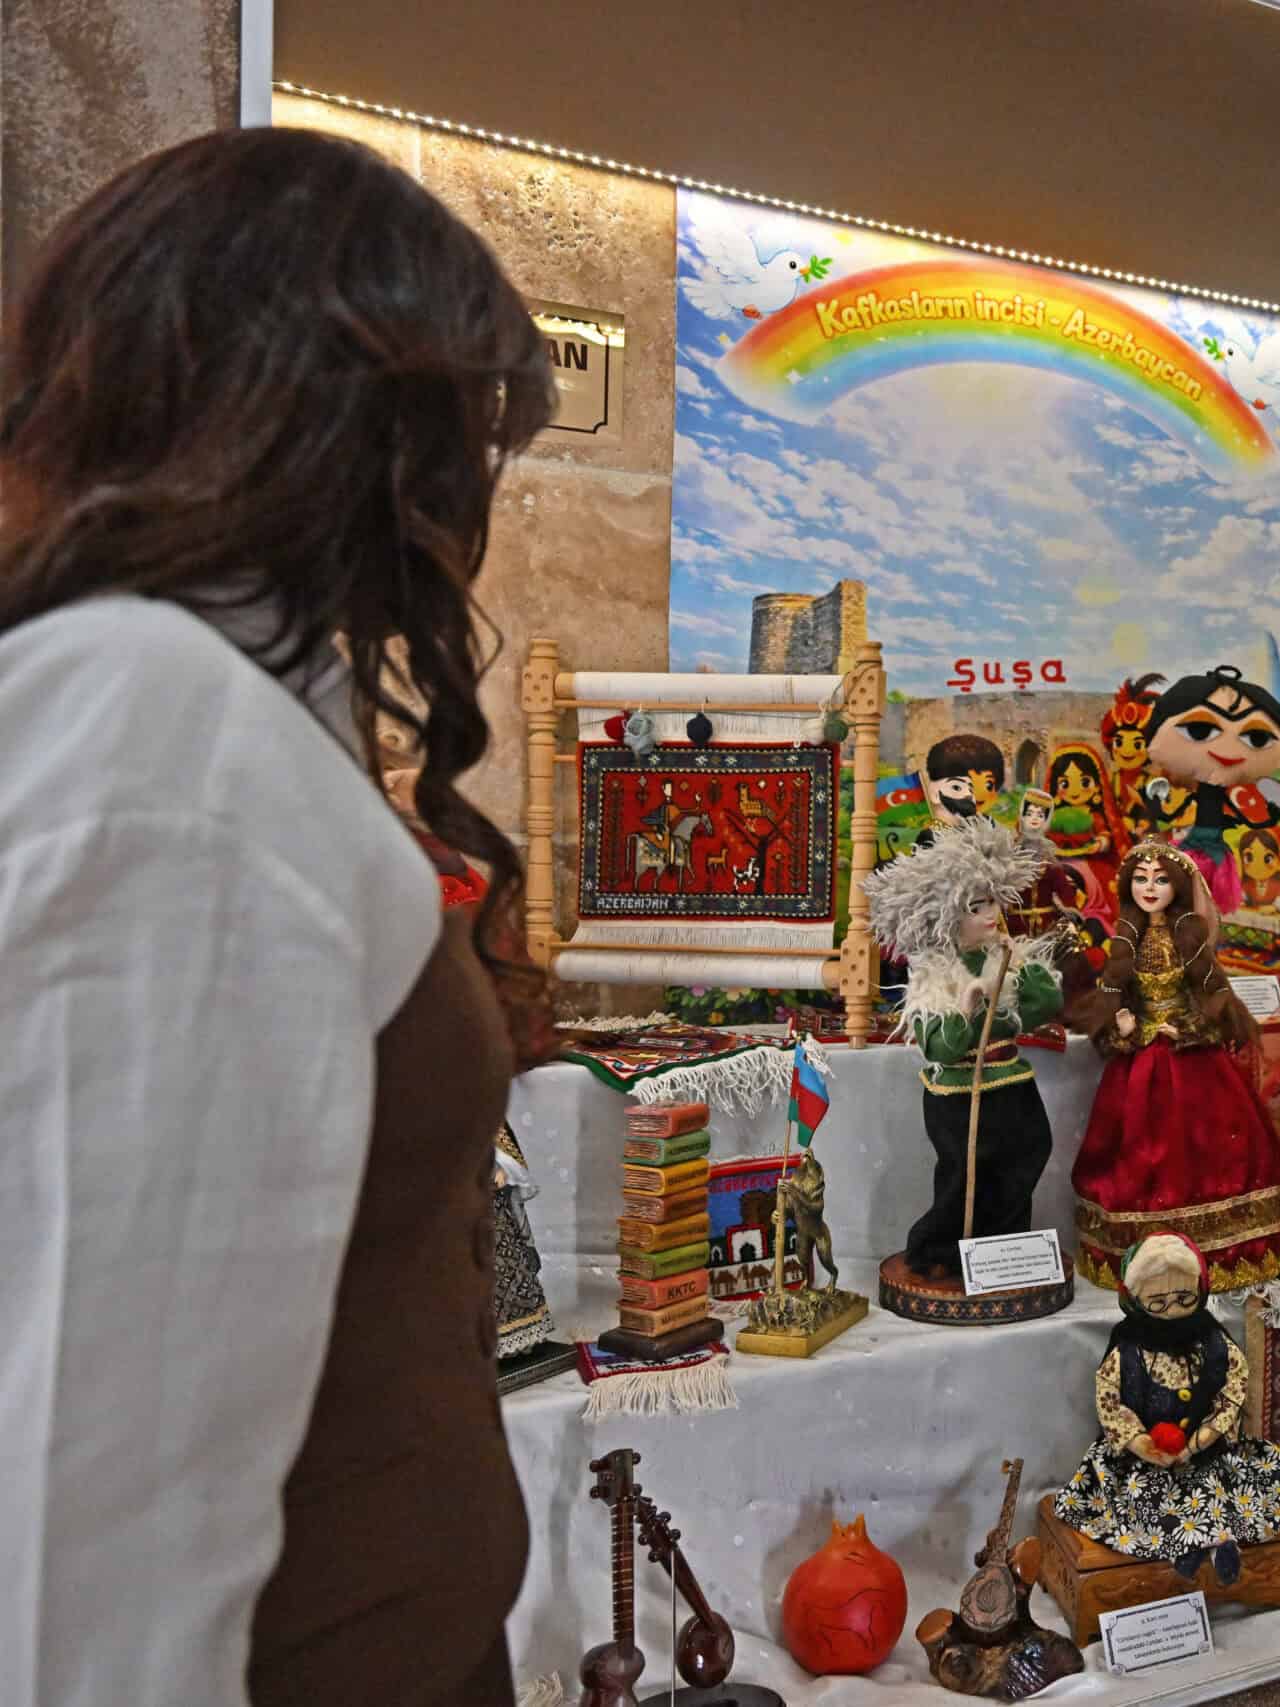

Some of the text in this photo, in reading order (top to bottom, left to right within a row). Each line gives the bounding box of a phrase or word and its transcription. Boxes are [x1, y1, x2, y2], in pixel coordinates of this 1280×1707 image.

[973, 290, 1045, 329] incisi
[1062, 307, 1203, 402] Azerbaycan
[945, 658, 1067, 693] Şuşa
[596, 897, 669, 909] AZERBAIJAN
[666, 1280, 697, 1300] KKTC
